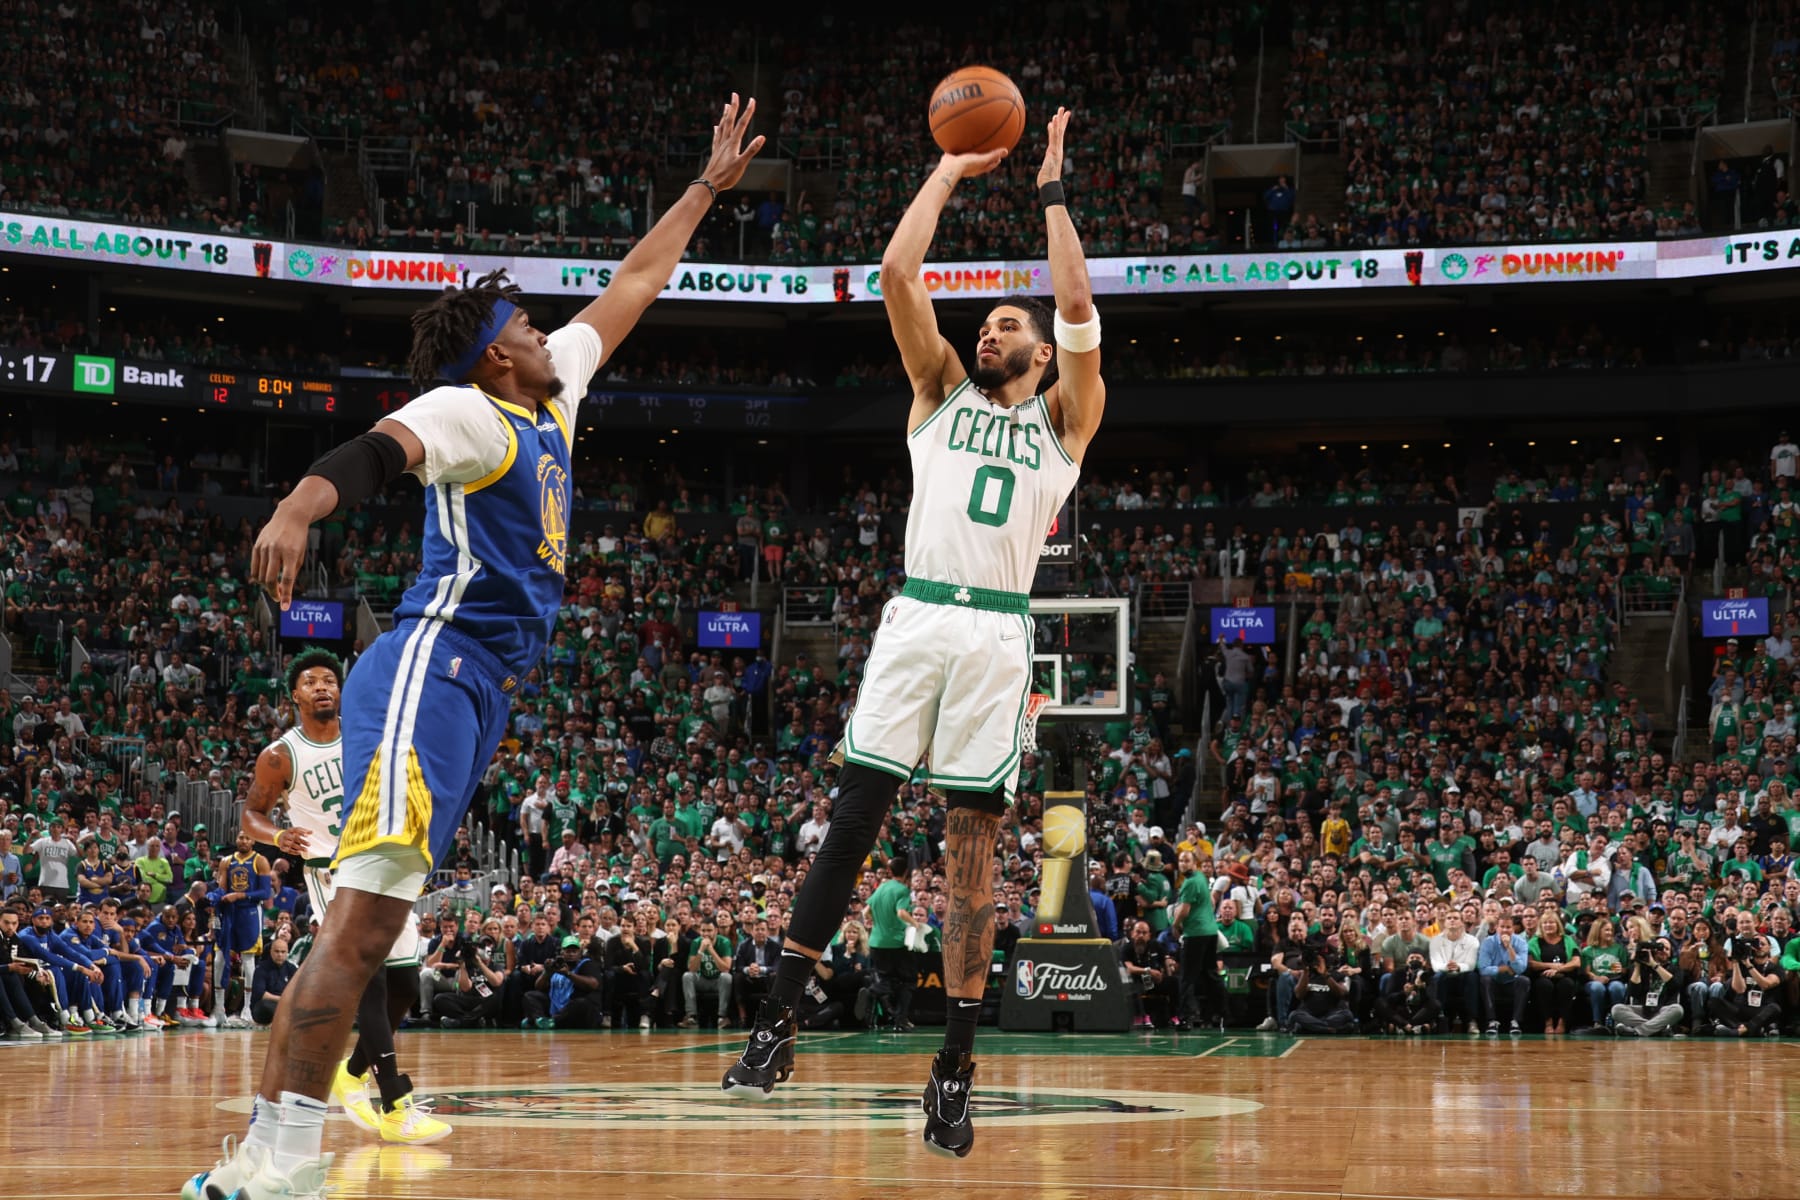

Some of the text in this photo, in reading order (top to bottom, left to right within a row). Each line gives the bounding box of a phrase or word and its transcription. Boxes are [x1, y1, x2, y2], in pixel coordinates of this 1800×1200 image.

[0, 221, 228, 265] 'S ALL ABOUT 18
[1725, 238, 1780, 265] IT'S
[1126, 258, 1378, 285] IT'S ALL ABOUT 18
[1502, 250, 1625, 276] DUNKIN'
[678, 271, 772, 294] ABOUT
[781, 274, 807, 294] 18
[923, 268, 1040, 292] DUNKIN'
[0, 354, 56, 383] :17
[78, 362, 184, 388] TD Bank
[213, 387, 228, 403] 12
[258, 377, 292, 395] 8:04
[325, 396, 335, 412] 2
[967, 464, 1016, 528] 0
[1040, 544, 1072, 556] SOT
[290, 611, 332, 623] ULTRA
[1221, 617, 1264, 628] ULTRA
[1712, 608, 1757, 620] ULTRA
[708, 621, 749, 632] ULTRA
[303, 757, 344, 800] CELT
[1024, 963, 1108, 1000] Finals
